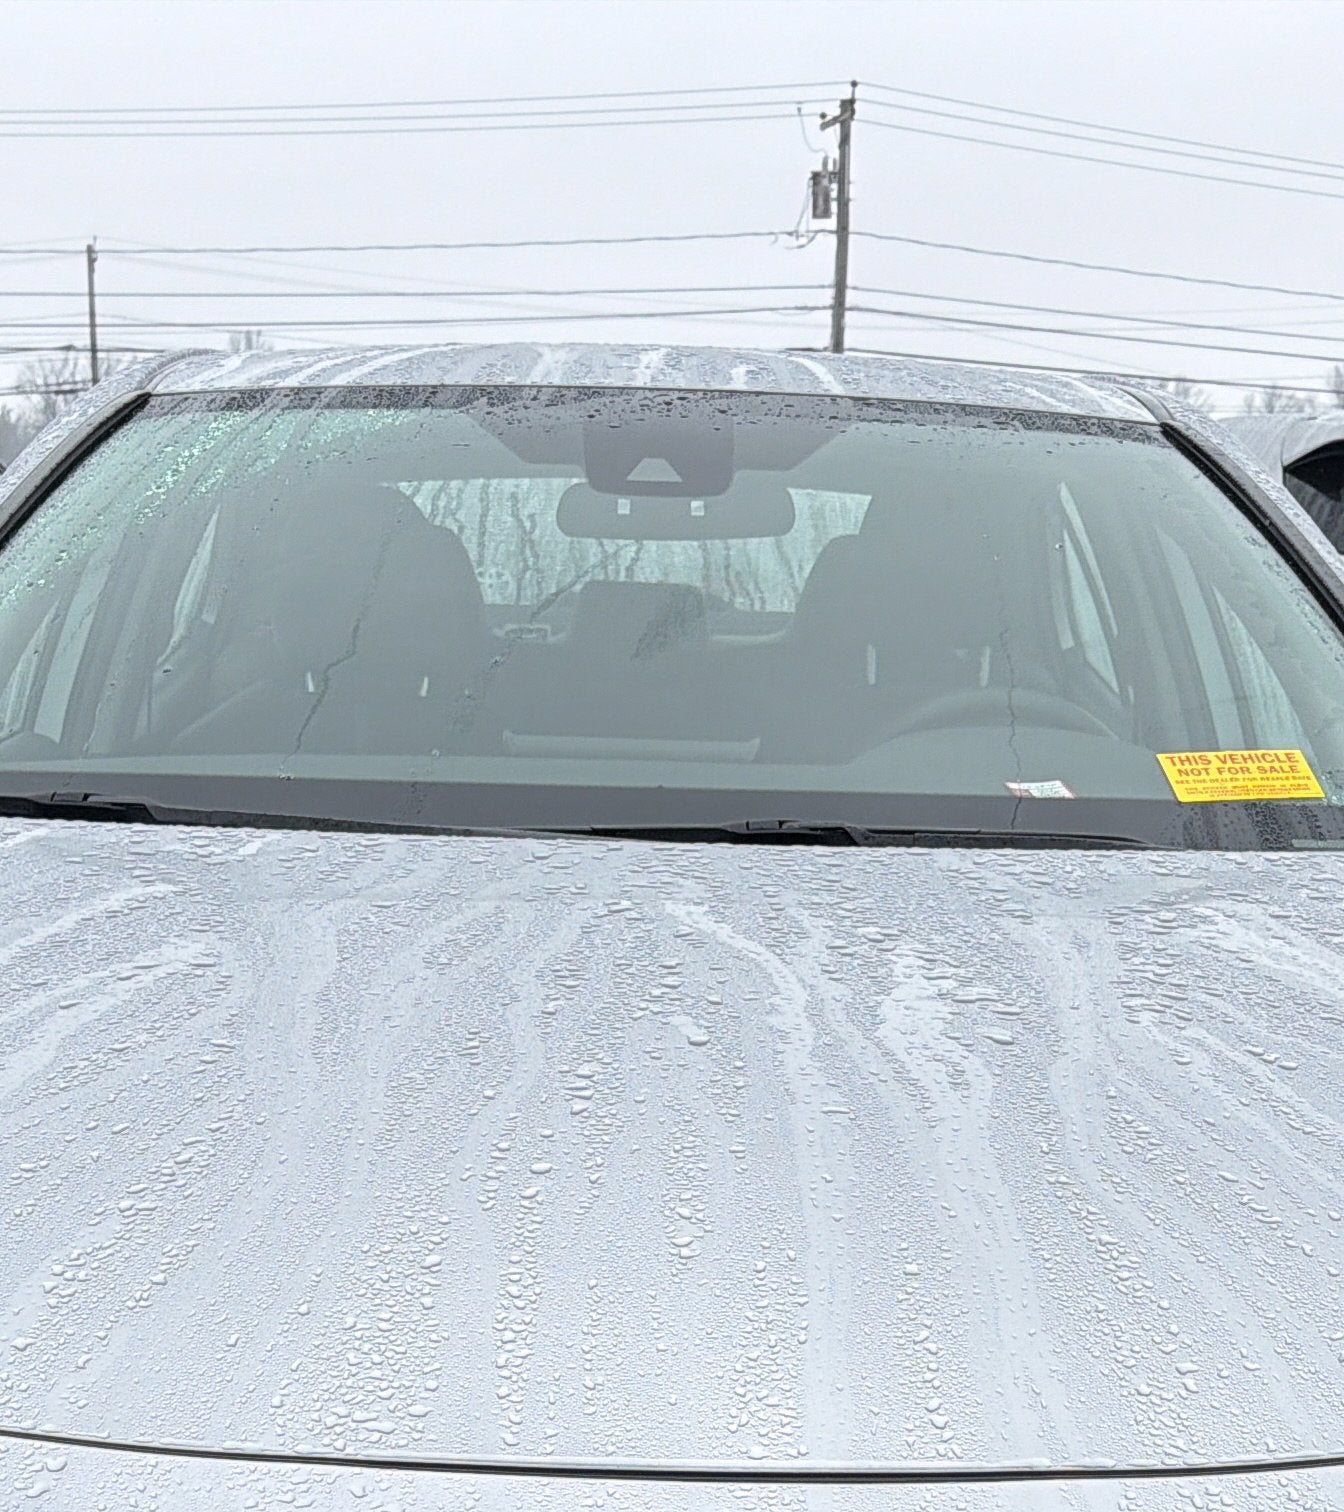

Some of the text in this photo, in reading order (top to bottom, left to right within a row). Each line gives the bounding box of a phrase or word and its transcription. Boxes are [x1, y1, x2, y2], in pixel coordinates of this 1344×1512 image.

[1166, 752, 1299, 768] THIS VEHICLE
[1177, 765, 1301, 777] NOT FOR SALE
